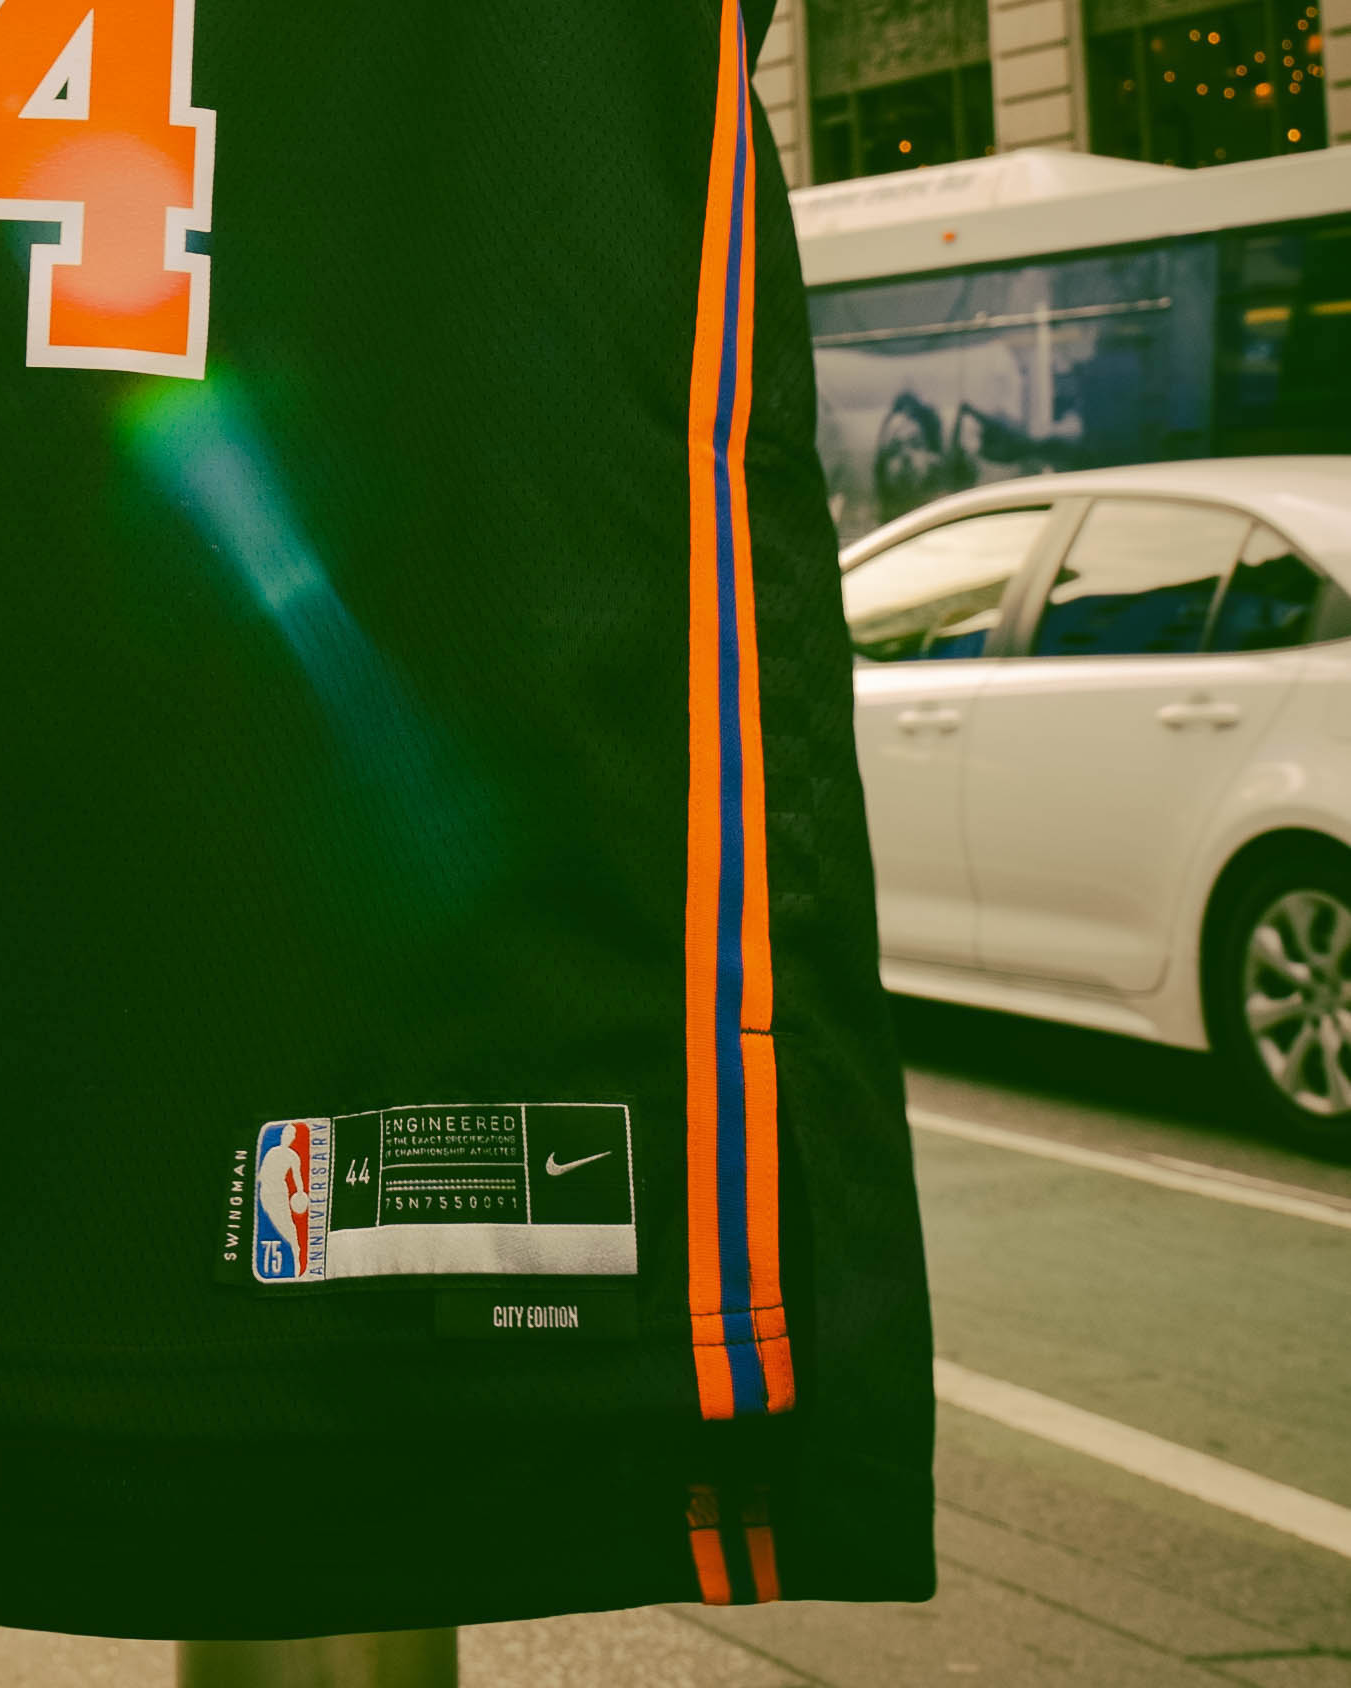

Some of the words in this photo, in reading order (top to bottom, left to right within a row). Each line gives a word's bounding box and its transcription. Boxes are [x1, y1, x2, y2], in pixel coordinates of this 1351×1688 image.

[385, 1116, 515, 1135] ENGINEERED
[345, 1156, 371, 1187] 44
[223, 1149, 249, 1261] SWINGMAN
[309, 1123, 328, 1276] ANNIVERSARY
[260, 1240, 283, 1276] 75
[493, 1305, 524, 1328] CITY
[527, 1305, 579, 1329] EDITION
